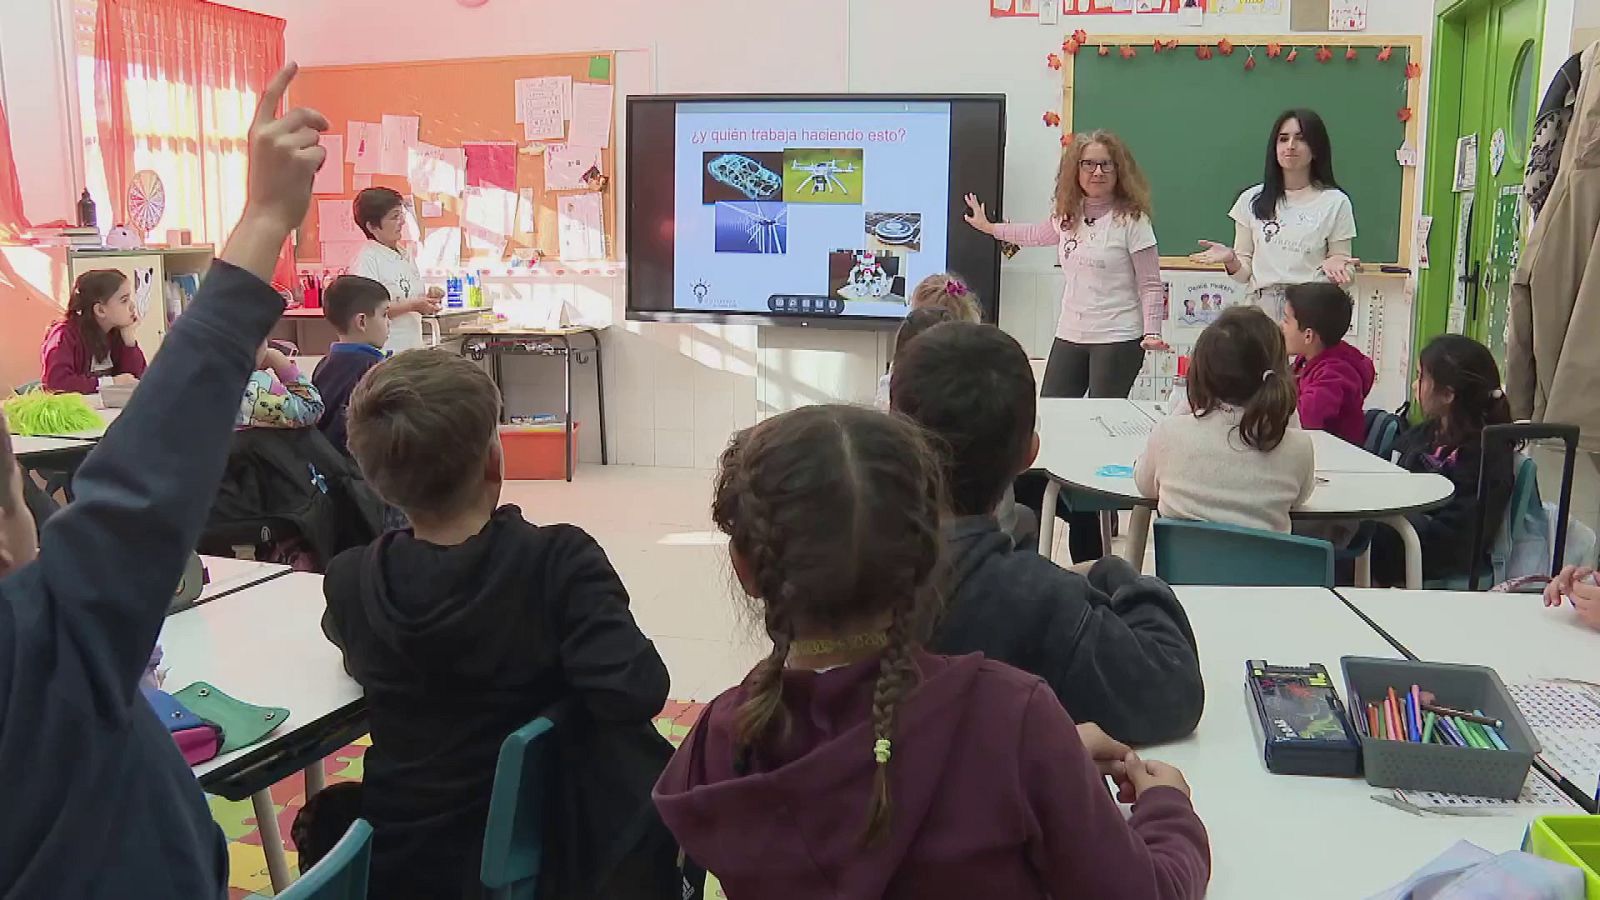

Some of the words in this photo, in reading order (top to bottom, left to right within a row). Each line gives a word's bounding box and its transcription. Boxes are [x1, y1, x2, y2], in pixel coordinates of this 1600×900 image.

[692, 130, 707, 144] ¿y
[711, 128, 747, 144] quién
[751, 127, 797, 144] trabaja
[801, 127, 864, 141] haciendo
[868, 127, 906, 142] esto?
